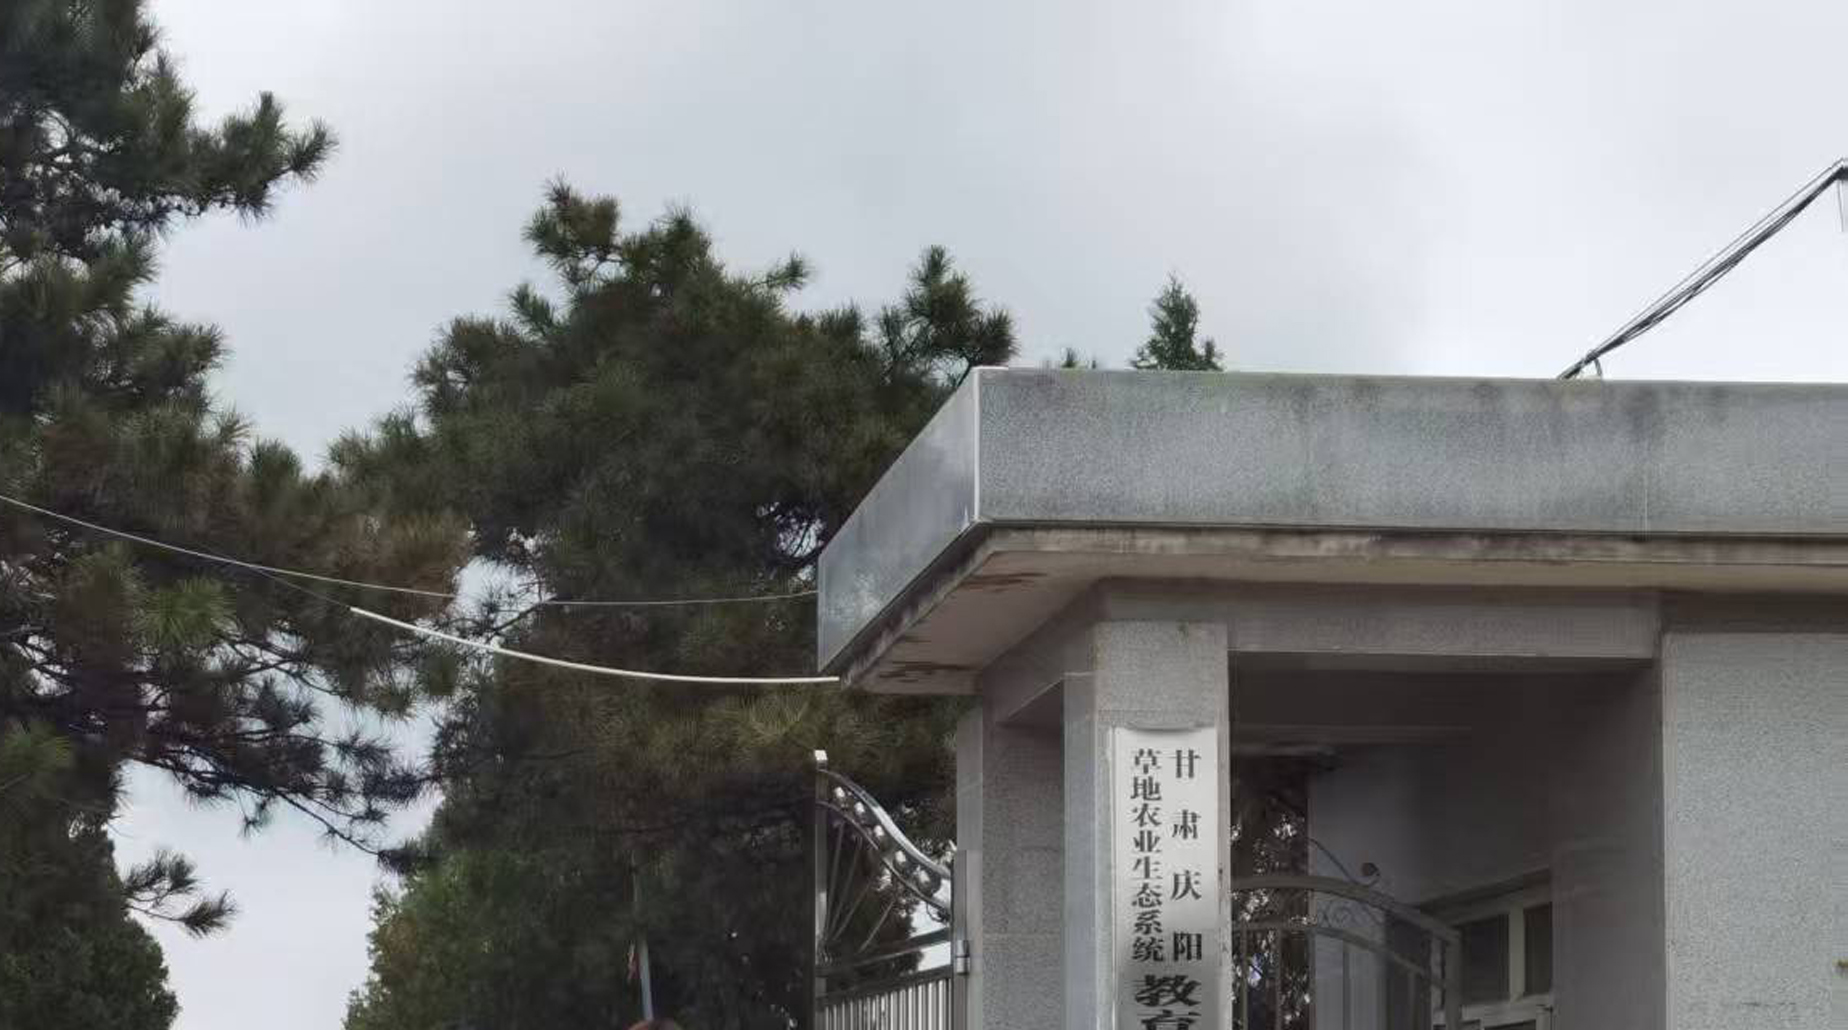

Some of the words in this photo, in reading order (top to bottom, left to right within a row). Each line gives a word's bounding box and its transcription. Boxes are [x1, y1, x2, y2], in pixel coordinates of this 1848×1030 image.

[1130, 748, 1164, 962] 草地农业生态系统
